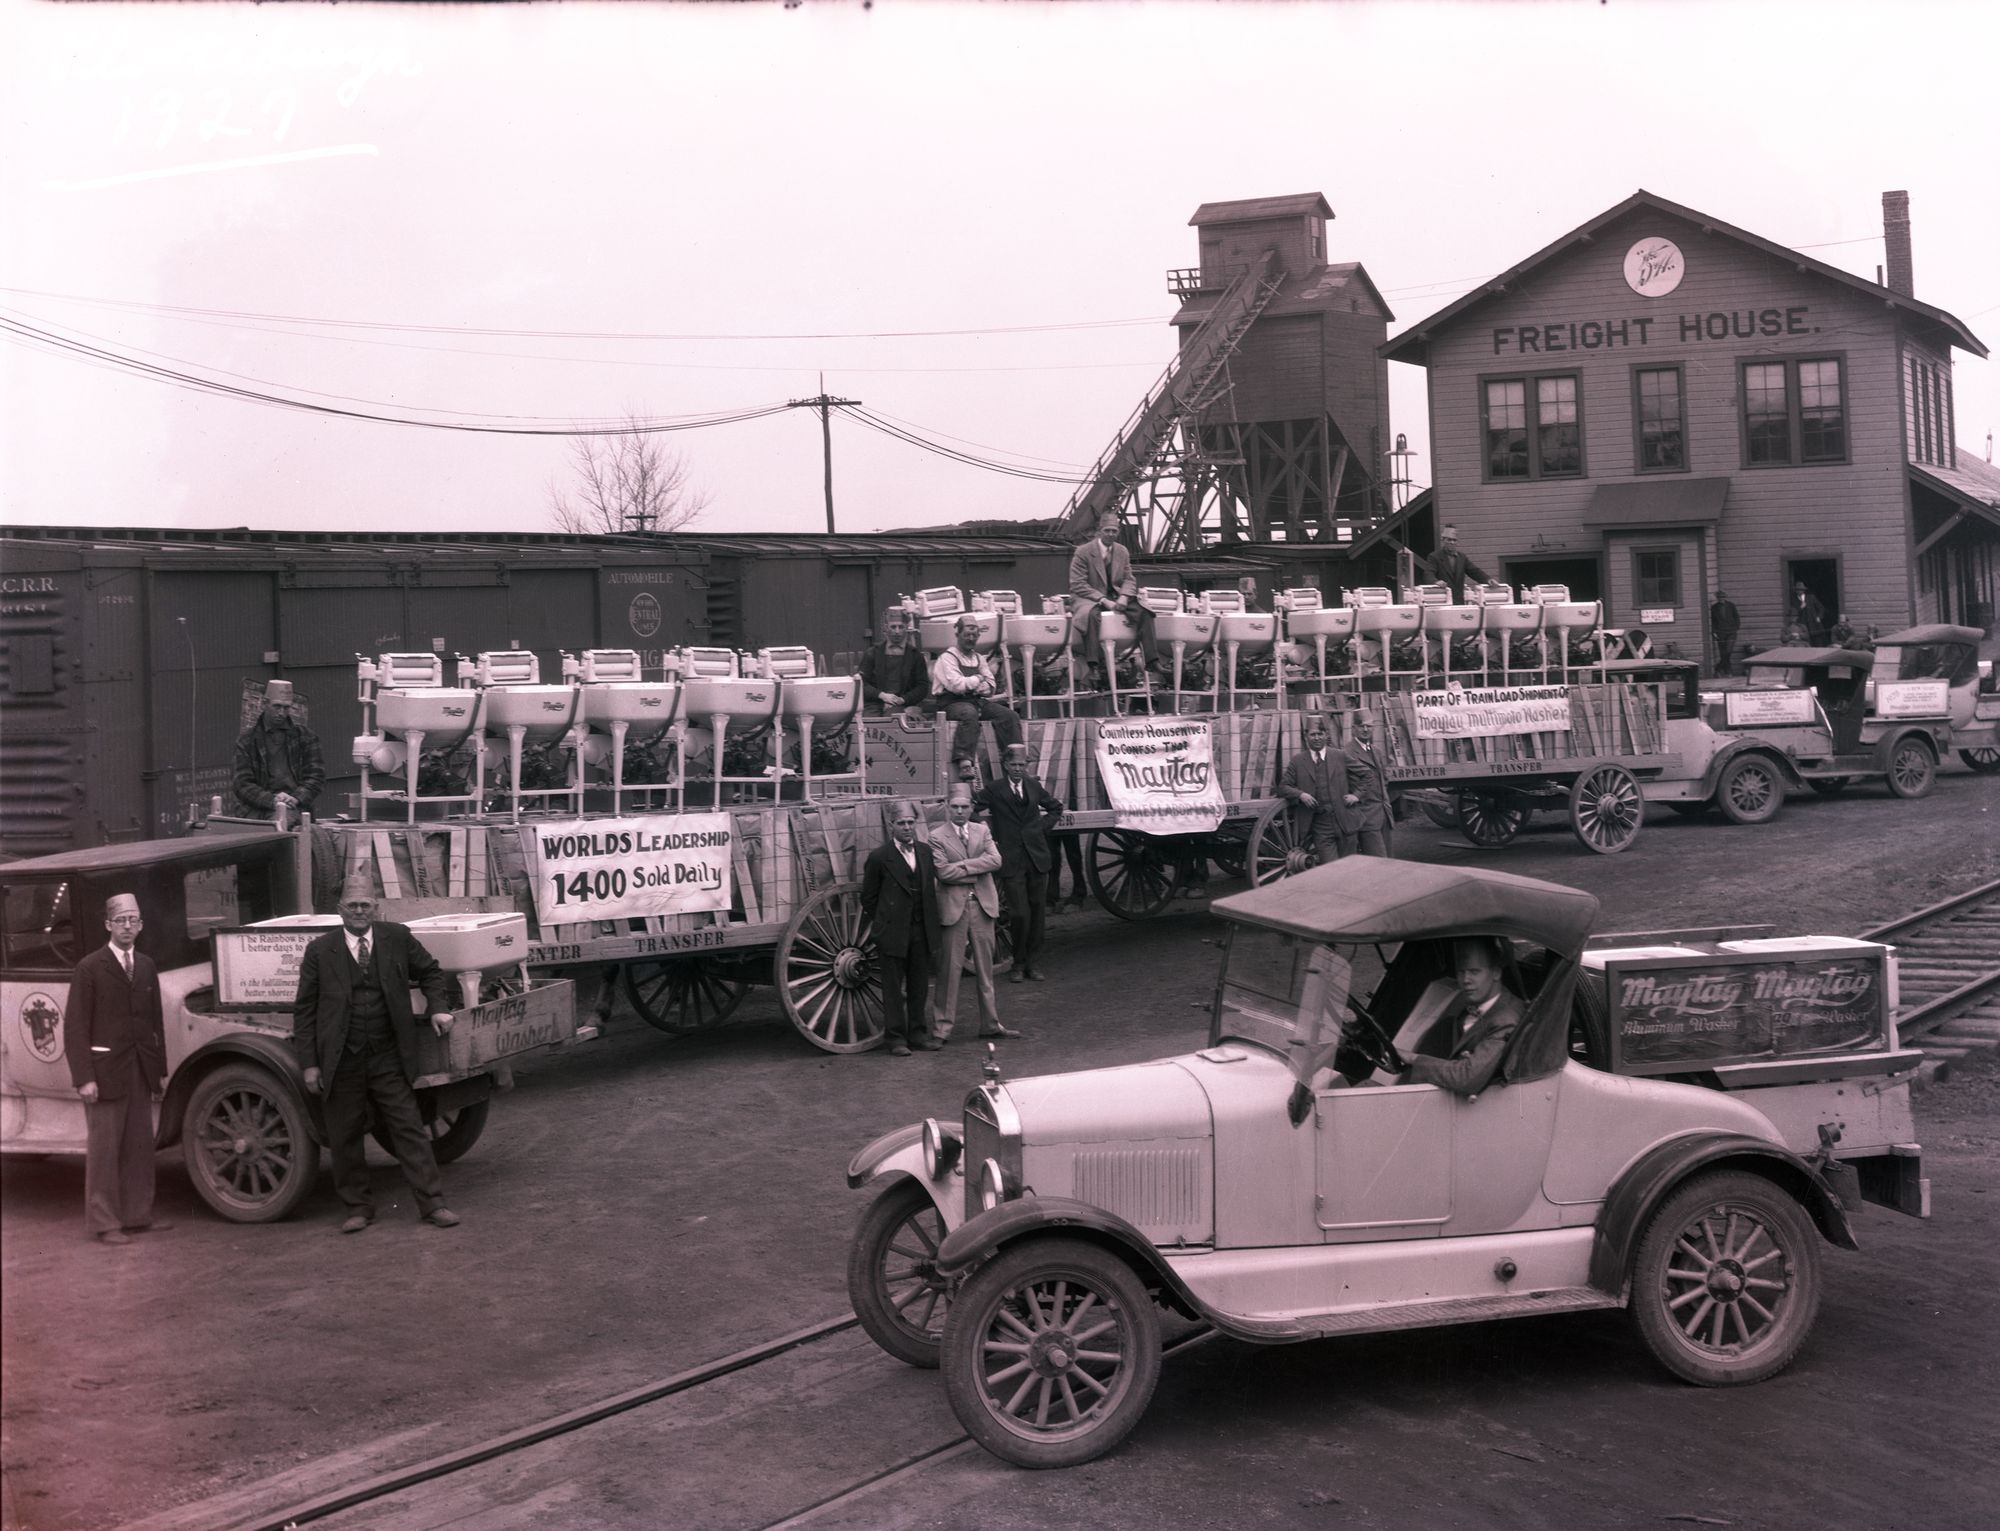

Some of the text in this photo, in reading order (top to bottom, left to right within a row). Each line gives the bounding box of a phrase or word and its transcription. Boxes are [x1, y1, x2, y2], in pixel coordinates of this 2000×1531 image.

[1494, 306, 1821, 355] FREIGHT HOUSE.
[607, 572, 674, 585] AUTOMOBILE
[1416, 694, 1445, 707] PART
[1463, 690, 1494, 705] TRAIN
[1494, 688, 1519, 703] LOAD
[1098, 724, 1145, 740] Countless
[864, 727, 917, 778] ARPENTER
[1113, 757, 1209, 797] Maytag
[1488, 761, 1543, 774] TRANSFER
[542, 832, 633, 860] WORLDS
[551, 861, 722, 906] 1400 Sold Daily
[238, 934, 257, 952] The
[259, 934, 296, 944] Rainbow
[298, 934, 305, 943] is
[248, 943, 304, 954] better days to
[526, 930, 725, 963] ENTER TRANSFER
[248, 978, 261, 987] the
[1620, 966, 1872, 1018] Maytag Maytag
[471, 998, 527, 1033] Maytag
[1620, 1016, 1741, 1036] Aluminum Washer
